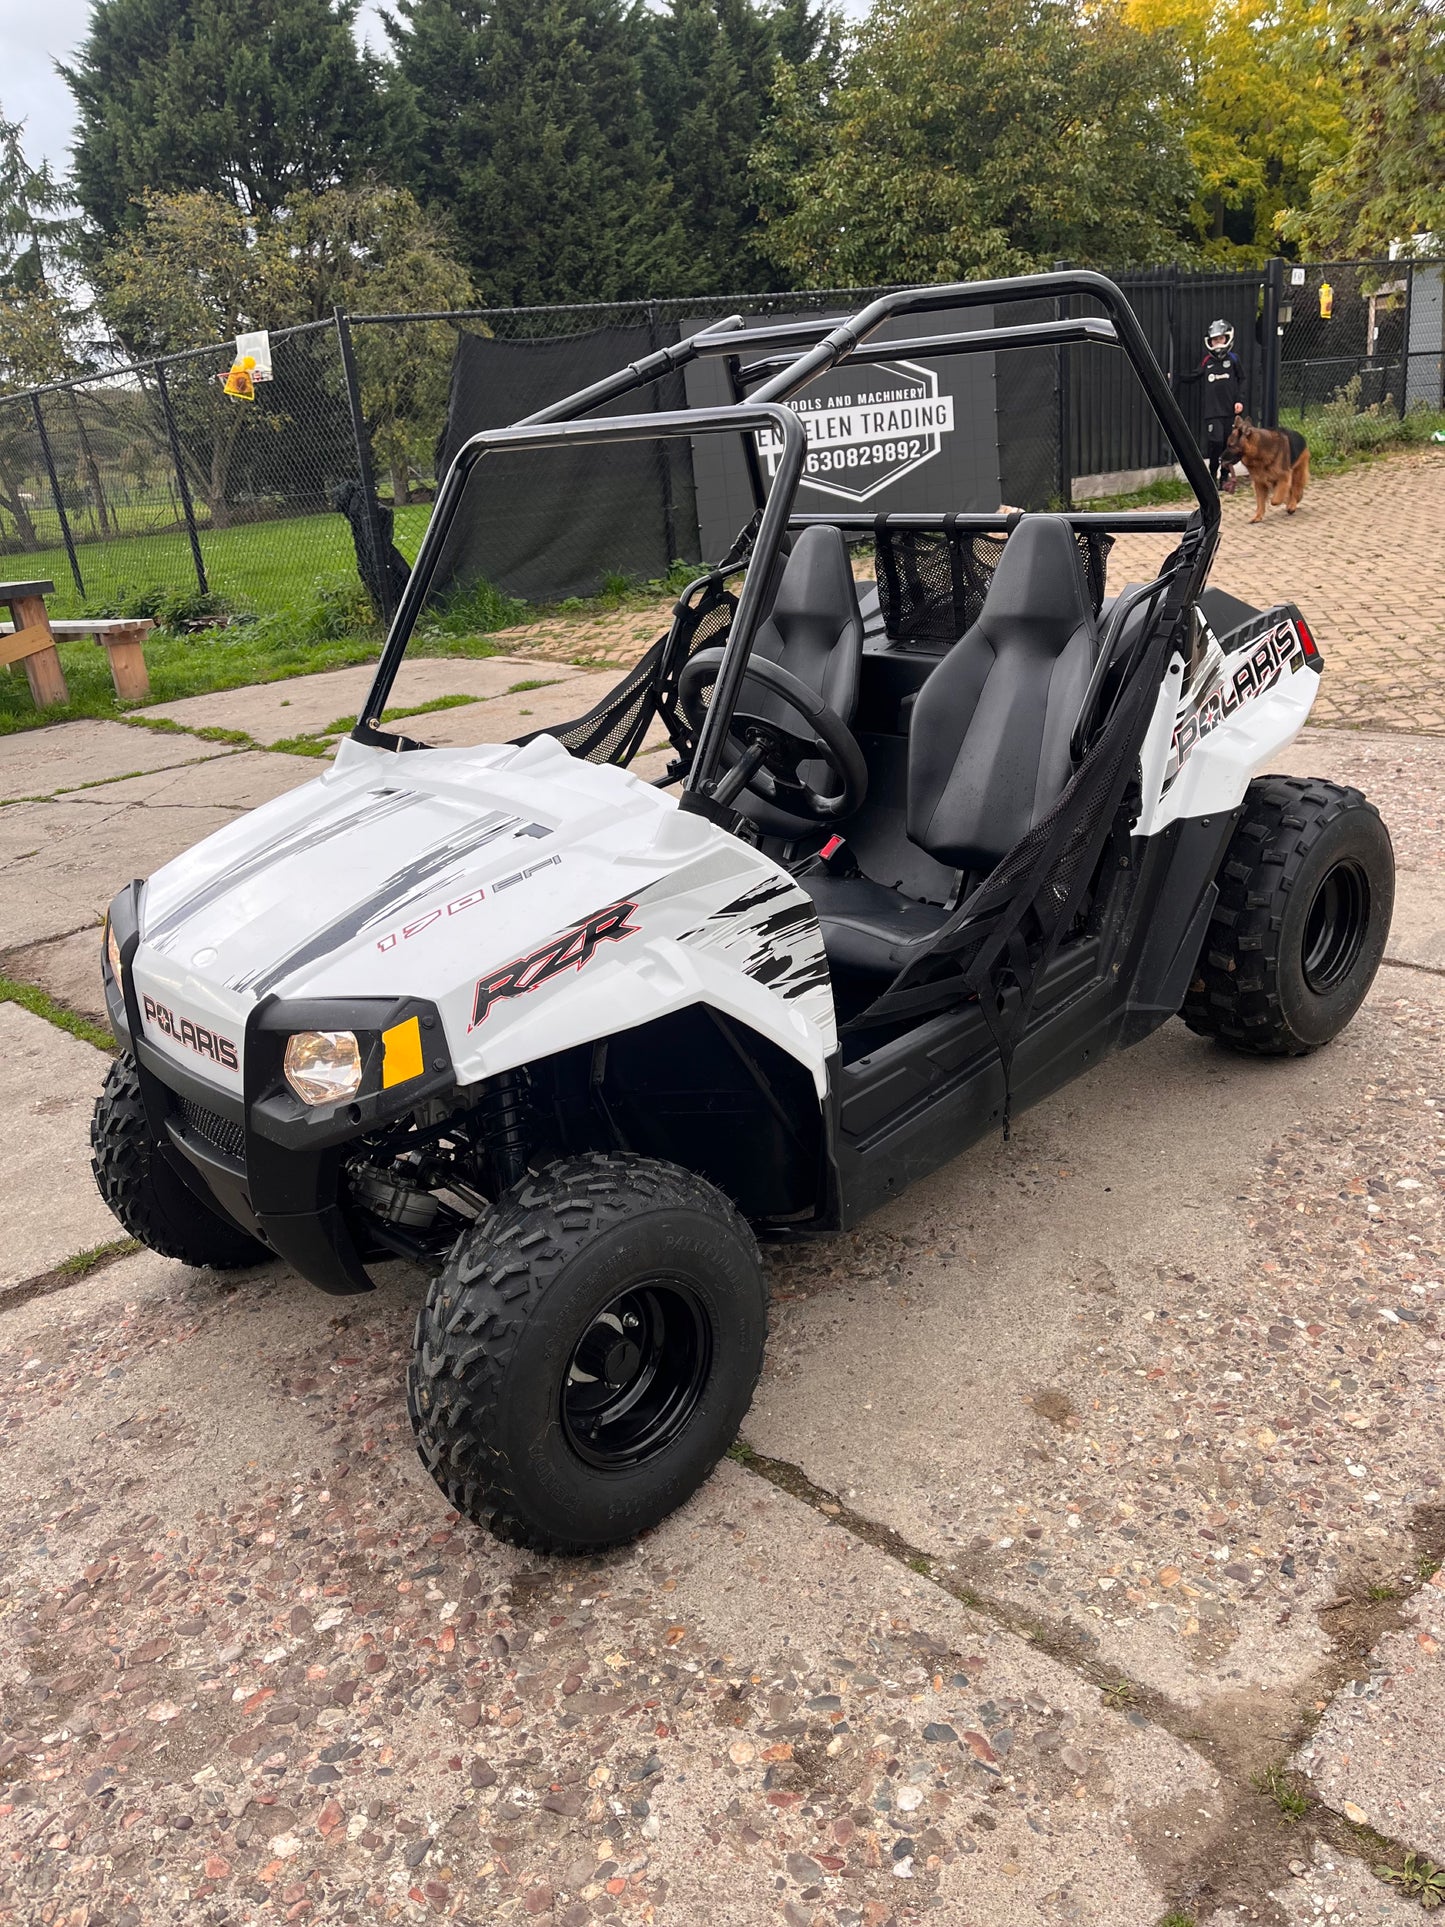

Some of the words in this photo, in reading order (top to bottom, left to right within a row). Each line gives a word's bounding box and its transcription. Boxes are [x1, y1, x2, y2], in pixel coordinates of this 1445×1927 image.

[783, 398, 822, 412] TOOLS
[827, 395, 852, 408] AND
[857, 387, 923, 404] MACHINERY
[860, 404, 947, 434] TRADING
[803, 439, 920, 474] 630829892
[1173, 619, 1298, 768] POLARIS
[492, 854, 562, 893] EFI
[467, 901, 642, 1034] RZR
[142, 992, 239, 1073] POLARIS
